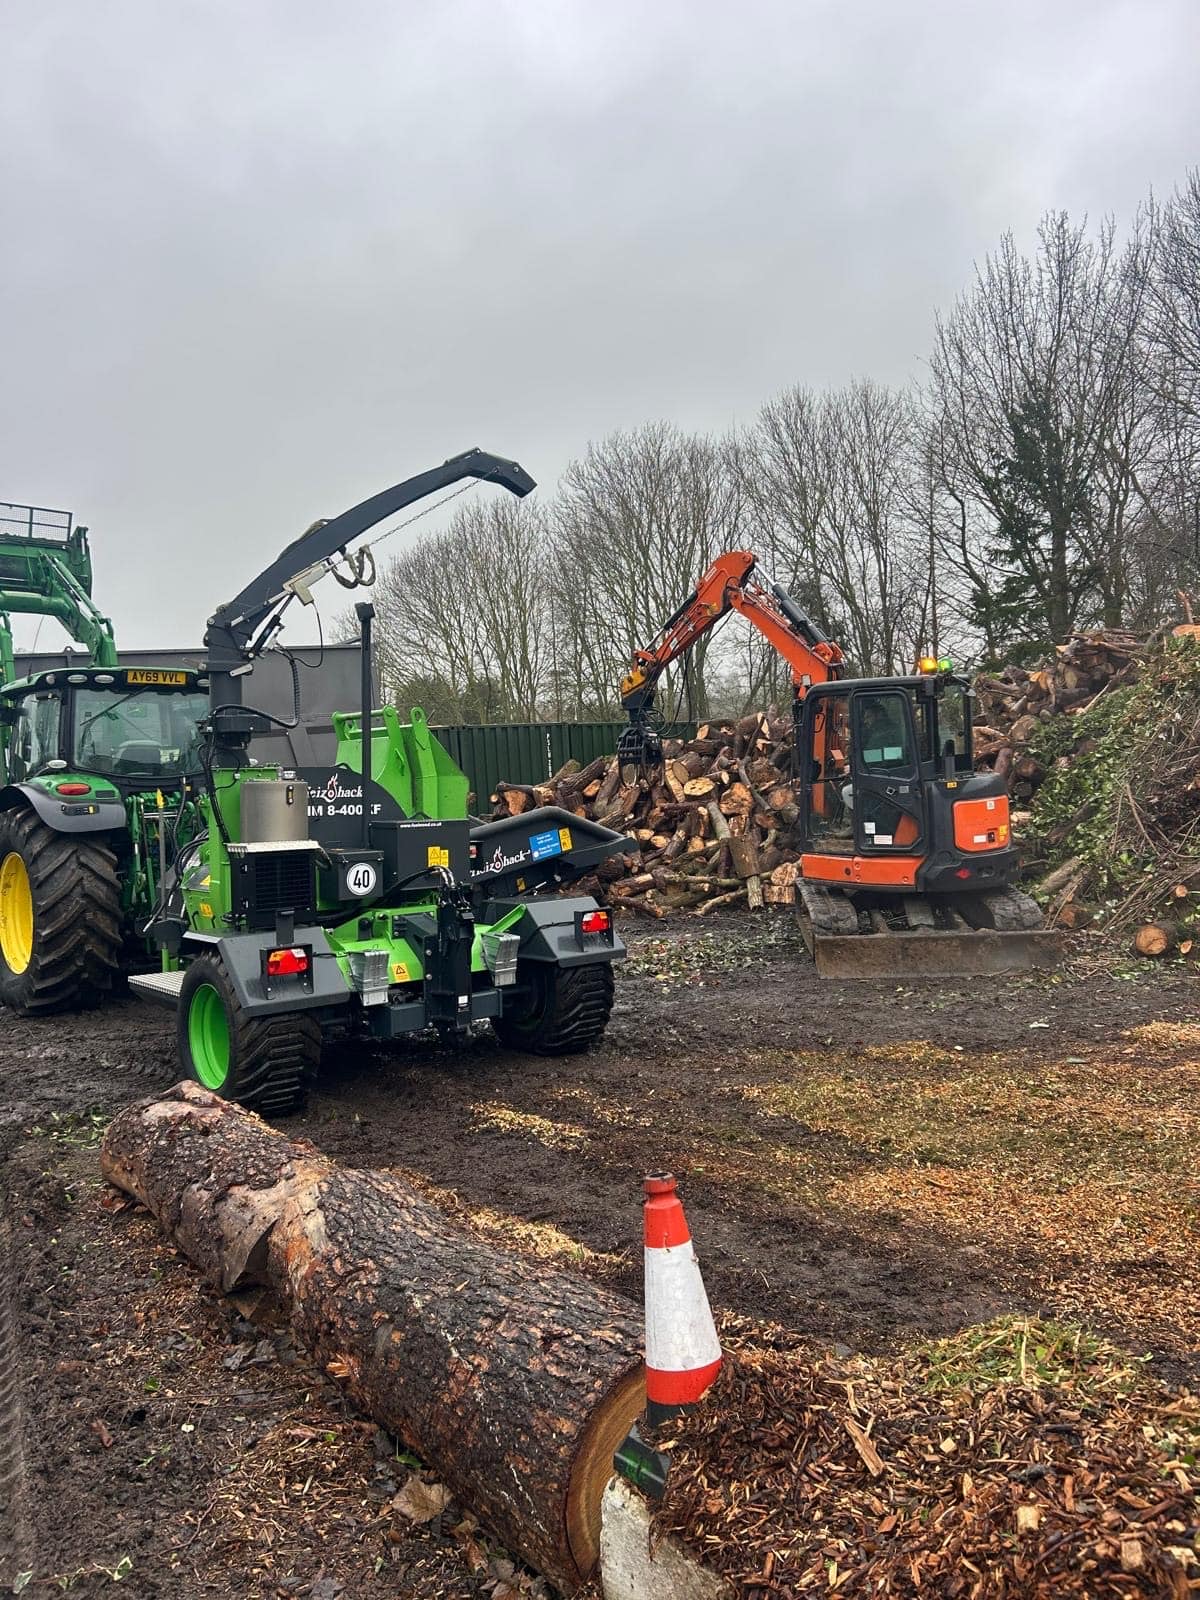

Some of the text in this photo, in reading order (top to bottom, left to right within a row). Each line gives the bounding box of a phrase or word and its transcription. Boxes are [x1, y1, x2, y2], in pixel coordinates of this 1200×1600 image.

[132, 671, 181, 683] AY69 VVL
[353, 869, 370, 889] 40
